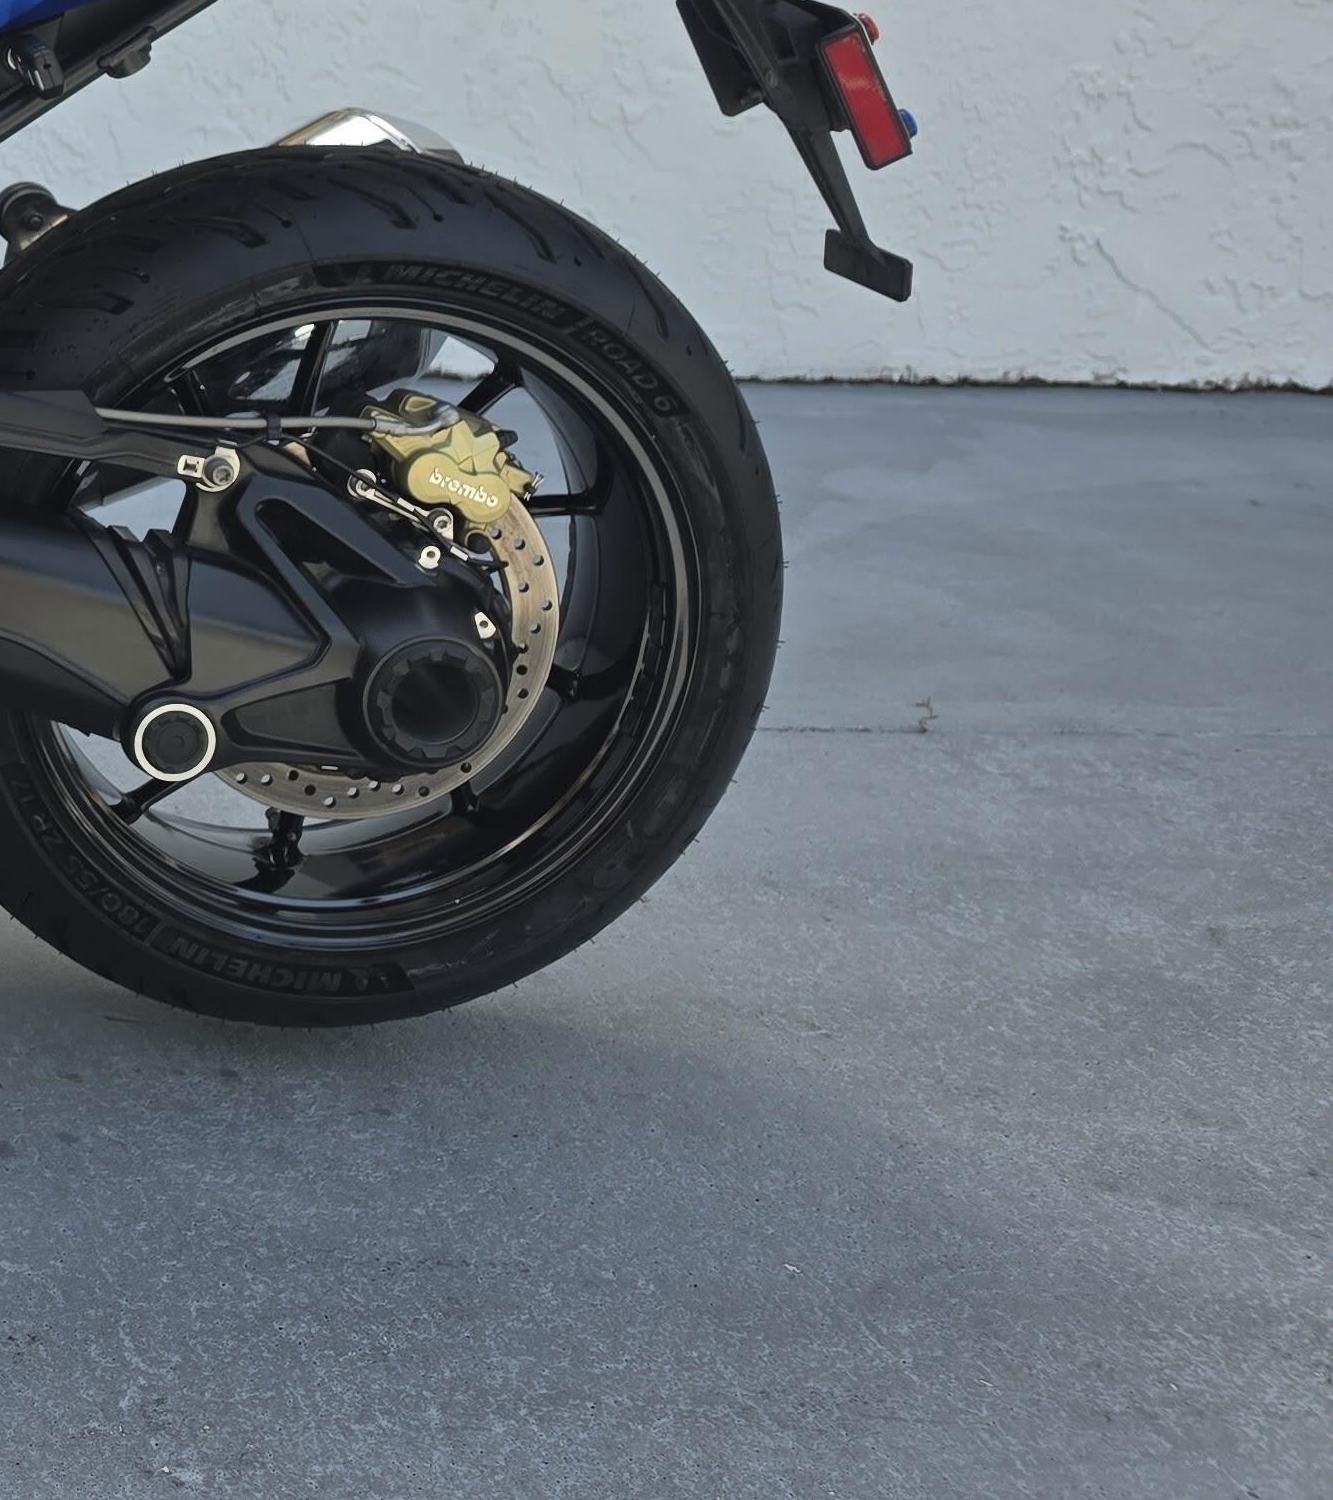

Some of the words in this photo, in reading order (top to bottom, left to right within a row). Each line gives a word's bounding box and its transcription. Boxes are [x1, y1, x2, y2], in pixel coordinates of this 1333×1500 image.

[382, 263, 568, 326] MICHELIN
[581, 325, 660, 392] ROAD
[652, 396, 679, 420] 6
[427, 466, 500, 508] brembo
[169, 932, 345, 993] MICHELIN
